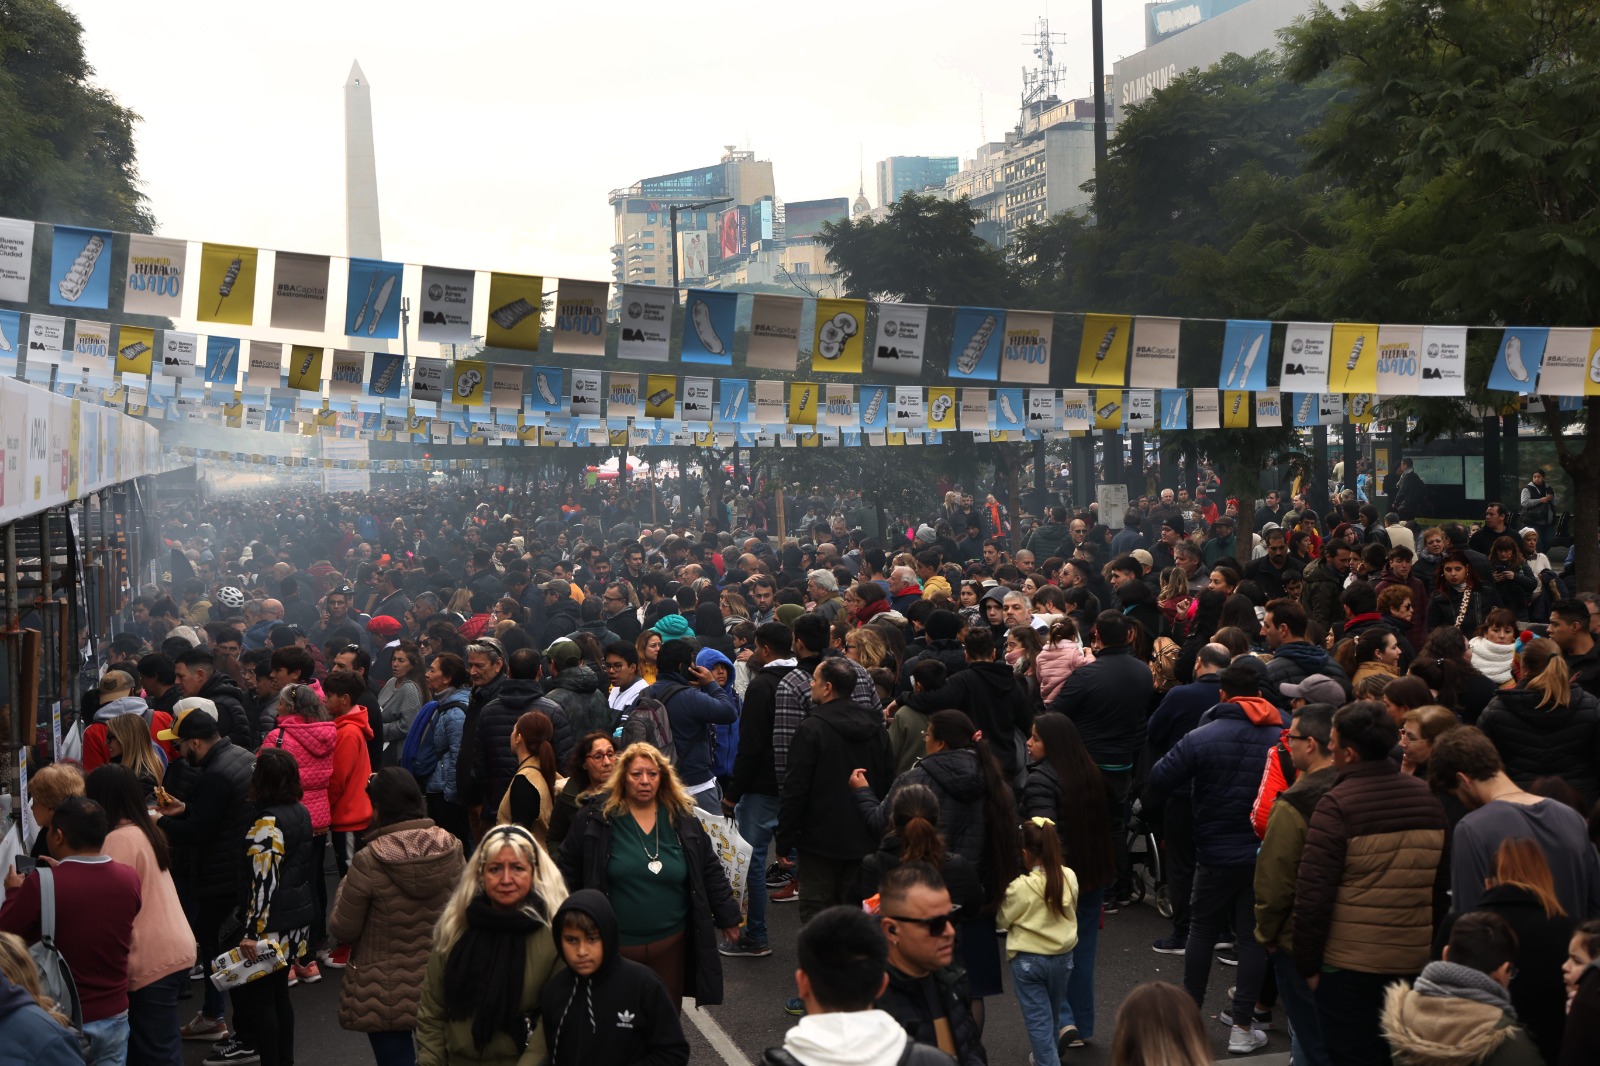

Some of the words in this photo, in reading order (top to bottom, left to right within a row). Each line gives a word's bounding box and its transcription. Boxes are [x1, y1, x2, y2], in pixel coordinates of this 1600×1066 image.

[130, 274, 179, 297] ASADO
[278, 284, 324, 294] #BACapital
[423, 311, 446, 325] BA
[557, 315, 602, 336] ASADO
[622, 328, 645, 342] BA
[30, 342, 45, 351] BA
[878, 346, 899, 359] BA
[165, 357, 179, 366] BA
[1006, 345, 1046, 365] ASADO
[1285, 363, 1305, 375] BA
[1377, 358, 1416, 376] ASADO
[1422, 368, 1442, 379] BA
[415, 382, 428, 391] BA
[30, 418, 46, 460] APOLO
